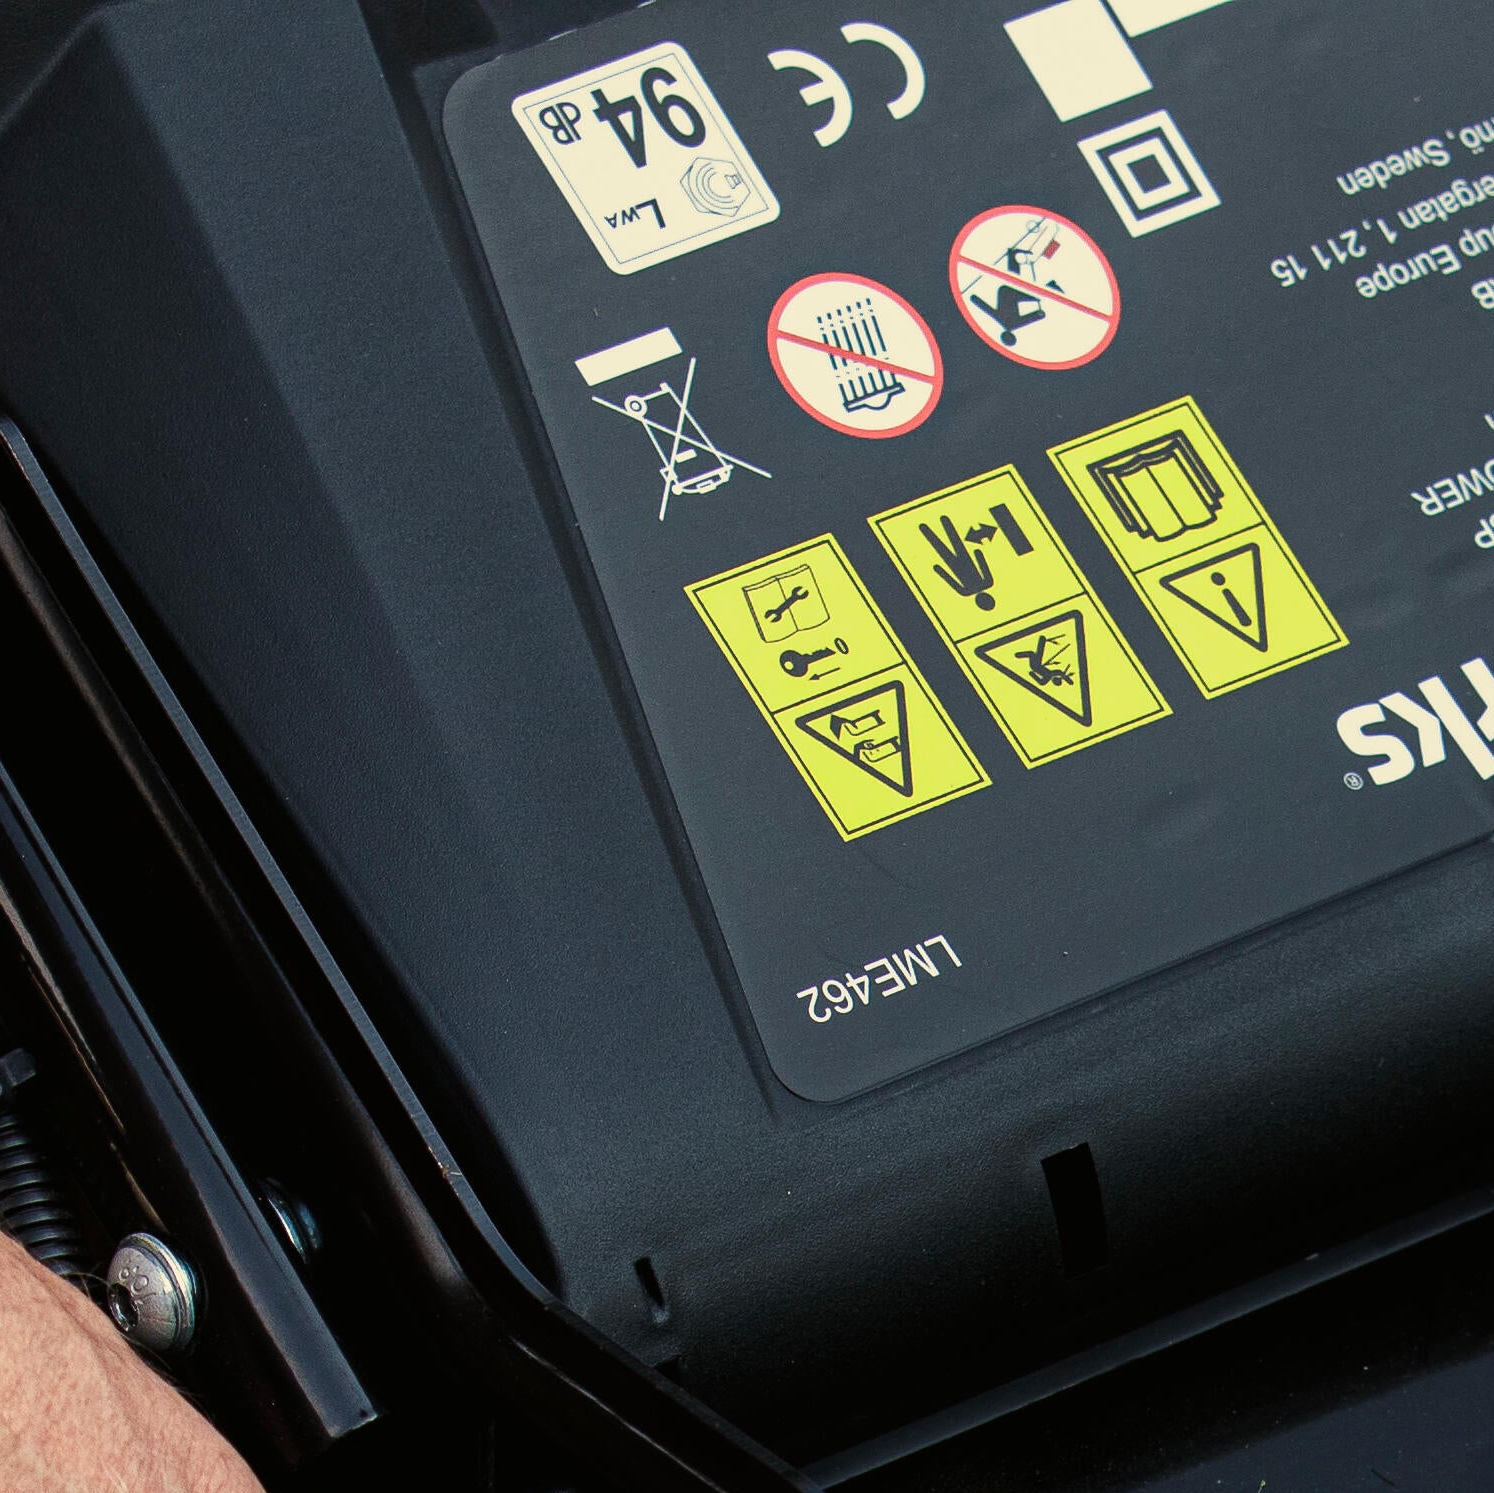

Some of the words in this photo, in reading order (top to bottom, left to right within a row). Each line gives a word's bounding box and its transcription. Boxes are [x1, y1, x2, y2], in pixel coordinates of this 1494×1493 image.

[539, 102, 582, 145] dB
[589, 67, 707, 168] 94
[1336, 138, 1451, 196] Sweden
[1270, 254, 1308, 288] 15
[1311, 229, 1367, 271] 211
[1355, 244, 1462, 298] Europe
[797, 934, 962, 1023] LME462
